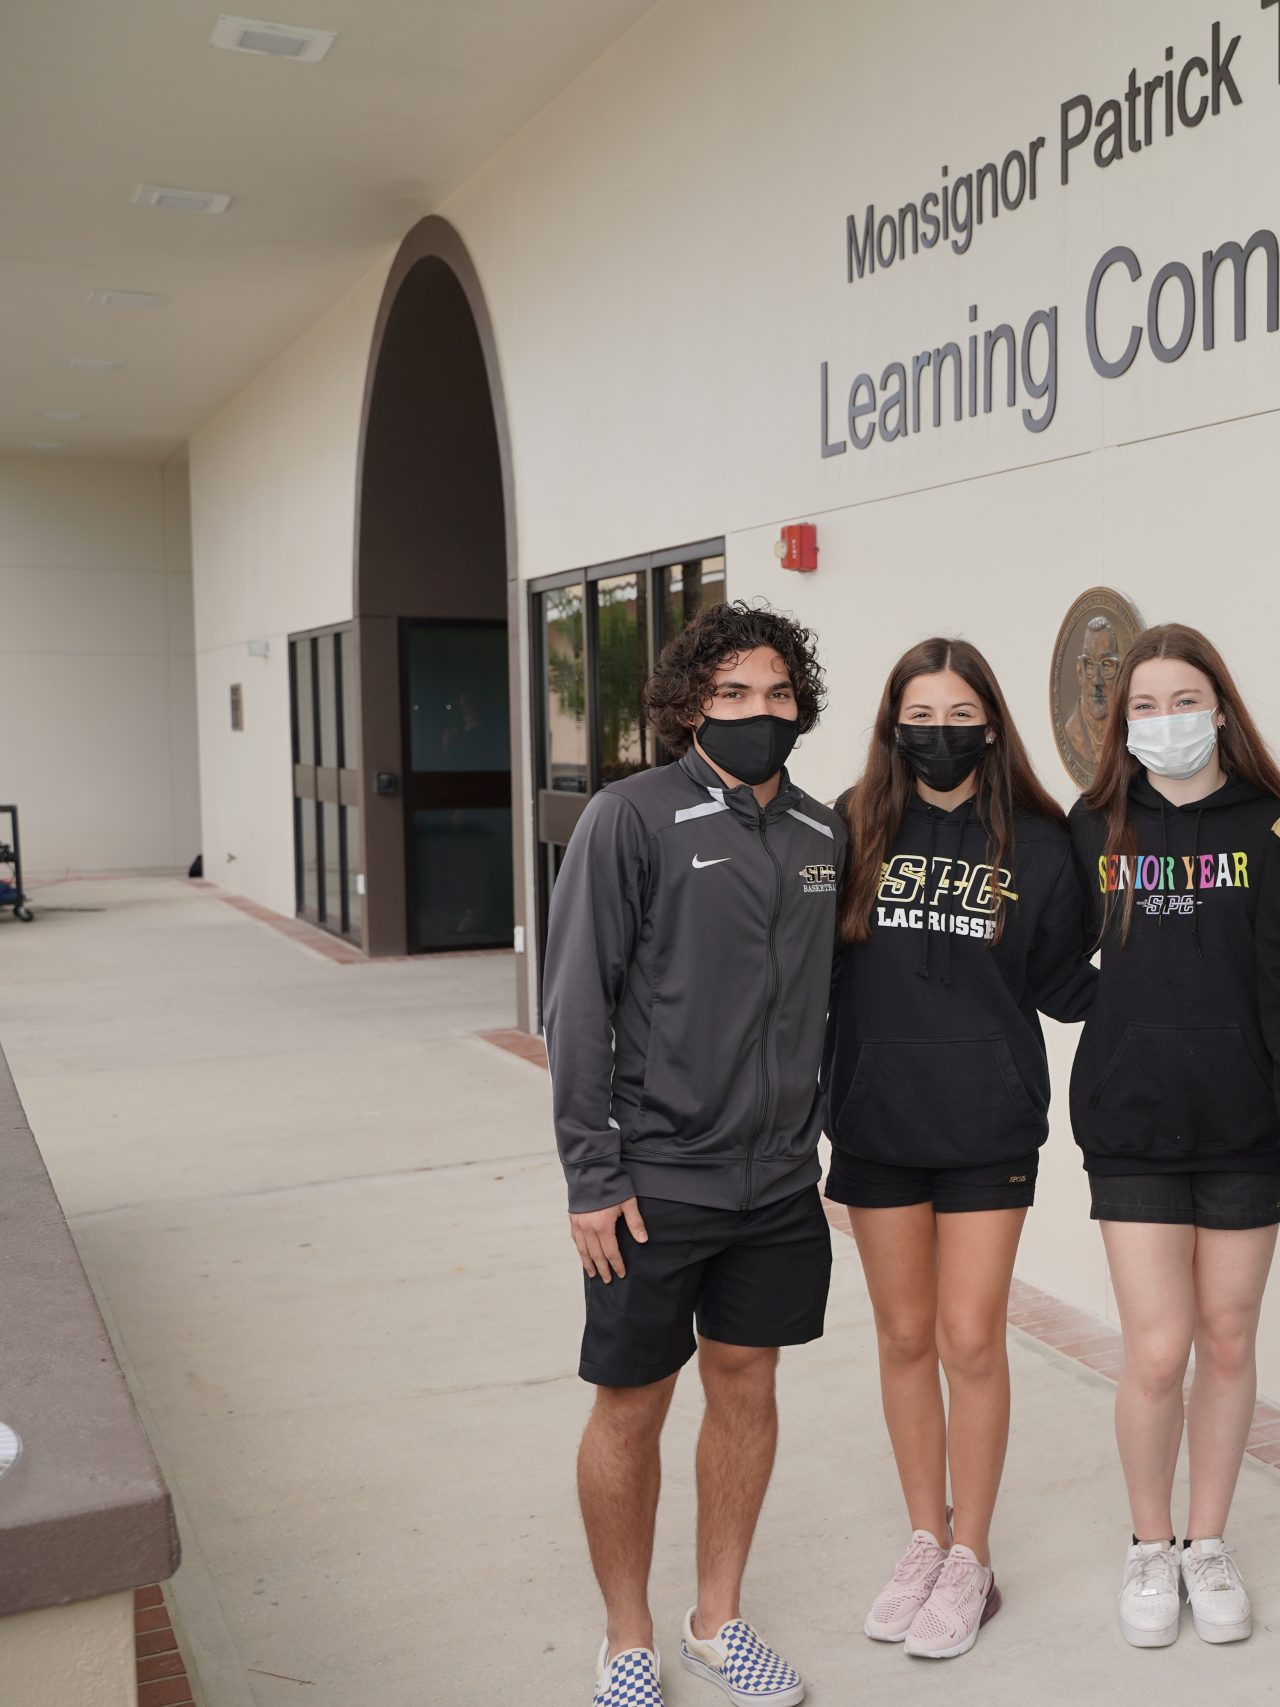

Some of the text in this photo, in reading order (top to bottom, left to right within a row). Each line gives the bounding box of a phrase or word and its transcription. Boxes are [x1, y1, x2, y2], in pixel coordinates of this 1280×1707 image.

[846, 134, 1046, 283] Monsignor
[1060, 21, 1242, 186] Patrick
[820, 304, 1058, 458] Learning
[803, 884, 837, 893] BASKETBA
[1098, 851, 1250, 894] SENIOR YEAR
[877, 906, 997, 940] LACROSSE
